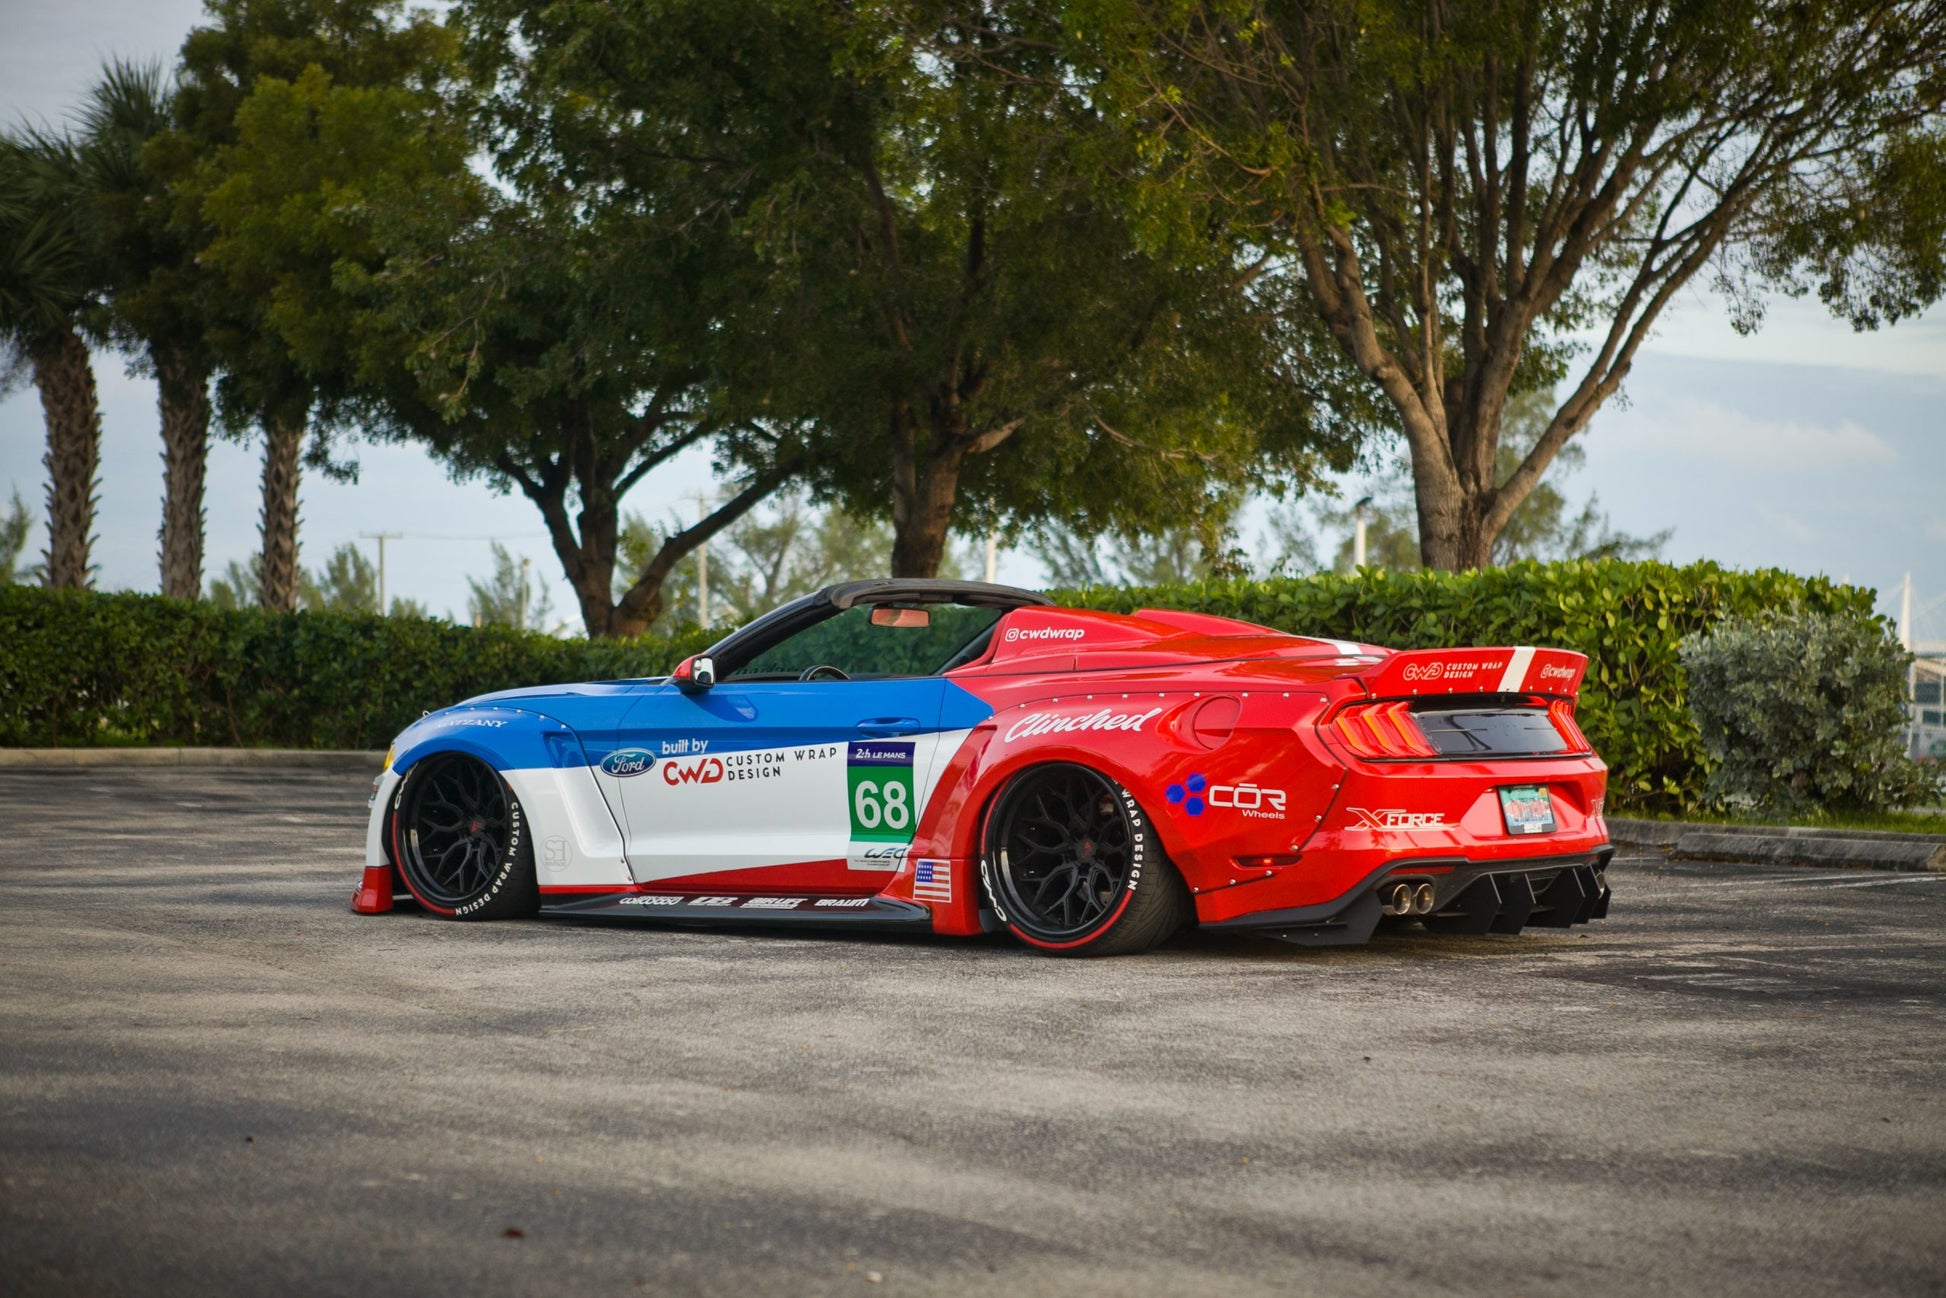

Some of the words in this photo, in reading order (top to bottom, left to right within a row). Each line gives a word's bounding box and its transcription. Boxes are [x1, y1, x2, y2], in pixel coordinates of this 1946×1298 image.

[1444, 671, 1474, 679] DESIGN
[1446, 663, 1478, 671] CUSTOM
[1481, 662, 1503, 670] WRAP
[1004, 708, 1163, 743] Clinched
[662, 739, 688, 755] built
[692, 738, 709, 753] by
[726, 752, 785, 767] CUSTOM
[794, 747, 838, 761] WRAP
[611, 753, 645, 773] Ford
[728, 767, 781, 780] DESIGN
[855, 780, 910, 829] 68
[1121, 789, 1141, 827] WRAP
[1242, 809, 1286, 820] Wheels
[509, 802, 520, 856] CUSTOM
[1127, 833, 1143, 891] DESIGN
[492, 862, 513, 893] WRAP
[455, 893, 491, 915] DESIGN
